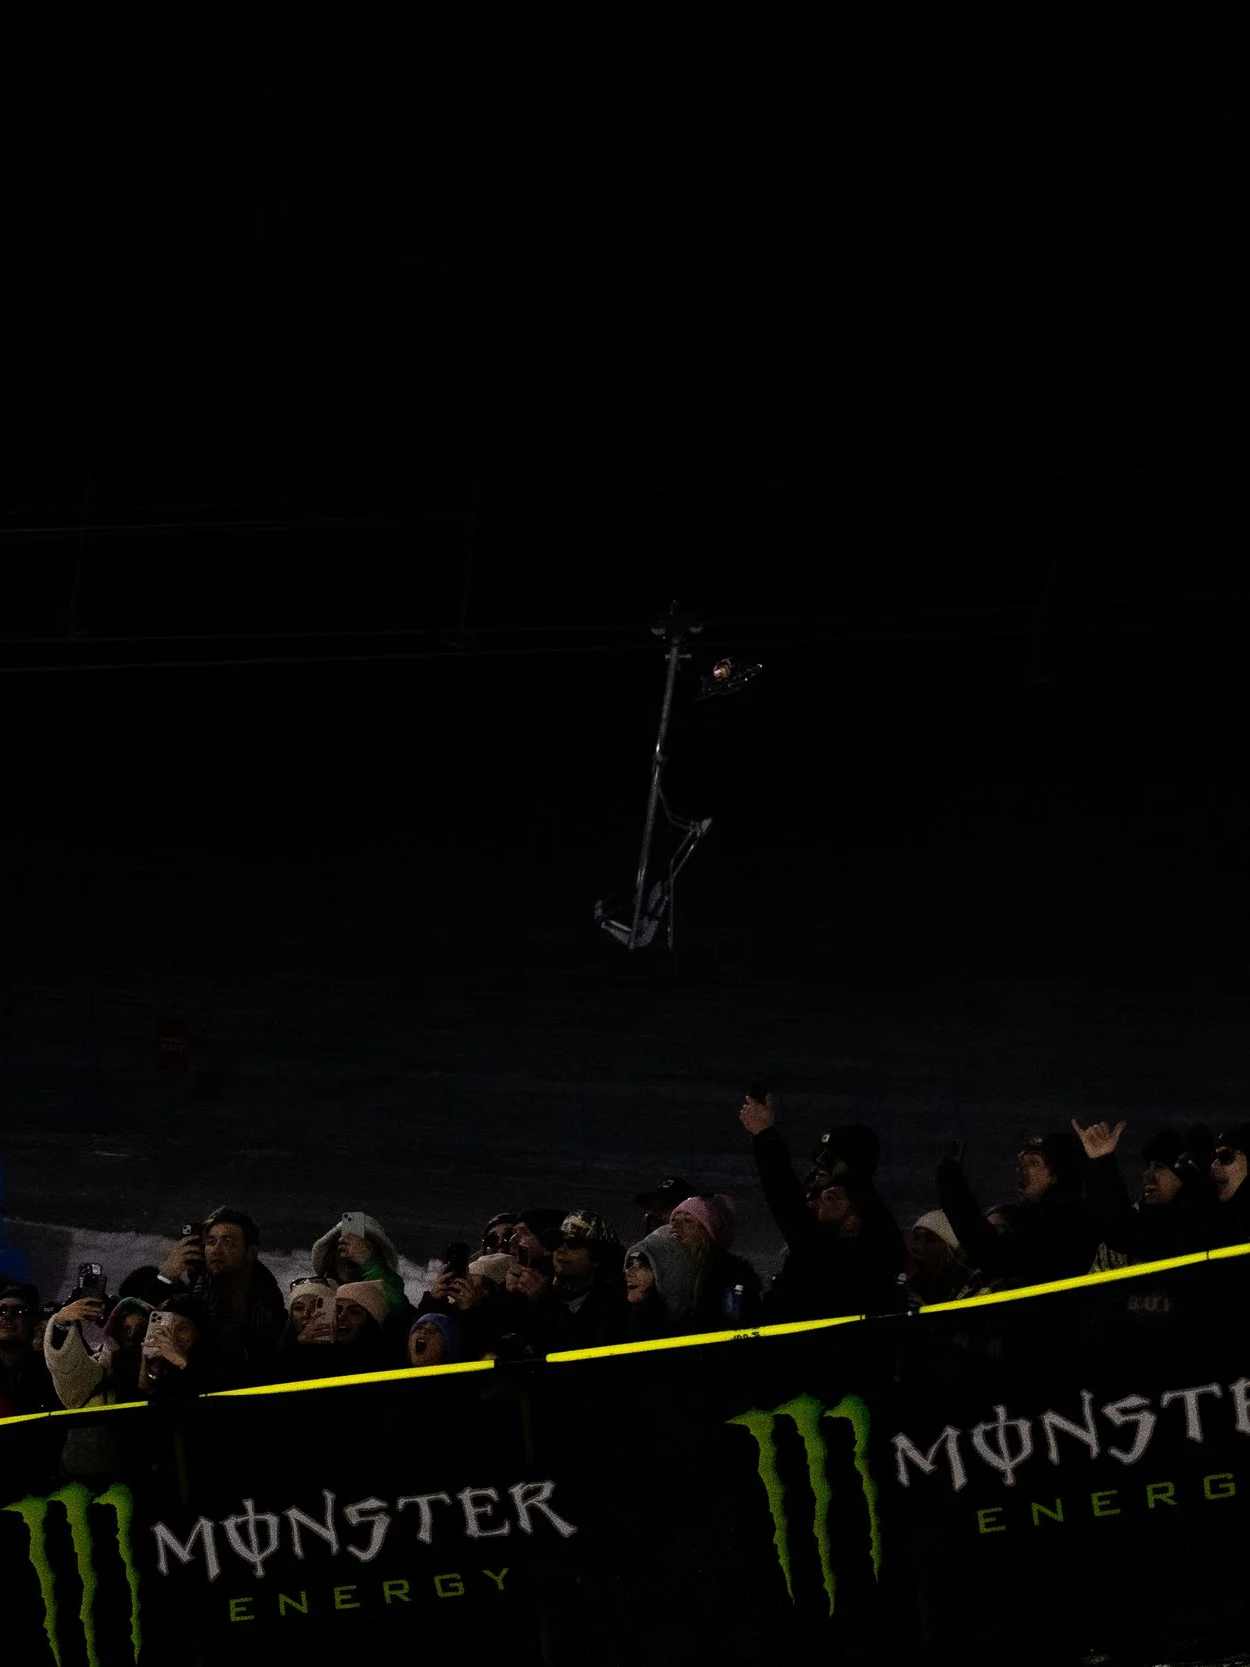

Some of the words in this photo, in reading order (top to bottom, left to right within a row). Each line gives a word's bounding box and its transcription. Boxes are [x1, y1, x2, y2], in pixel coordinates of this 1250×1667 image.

[151, 1479, 578, 1582] MONSTER
[976, 1472, 1237, 1535] ENERG
[229, 1567, 510, 1623] ENERGY
